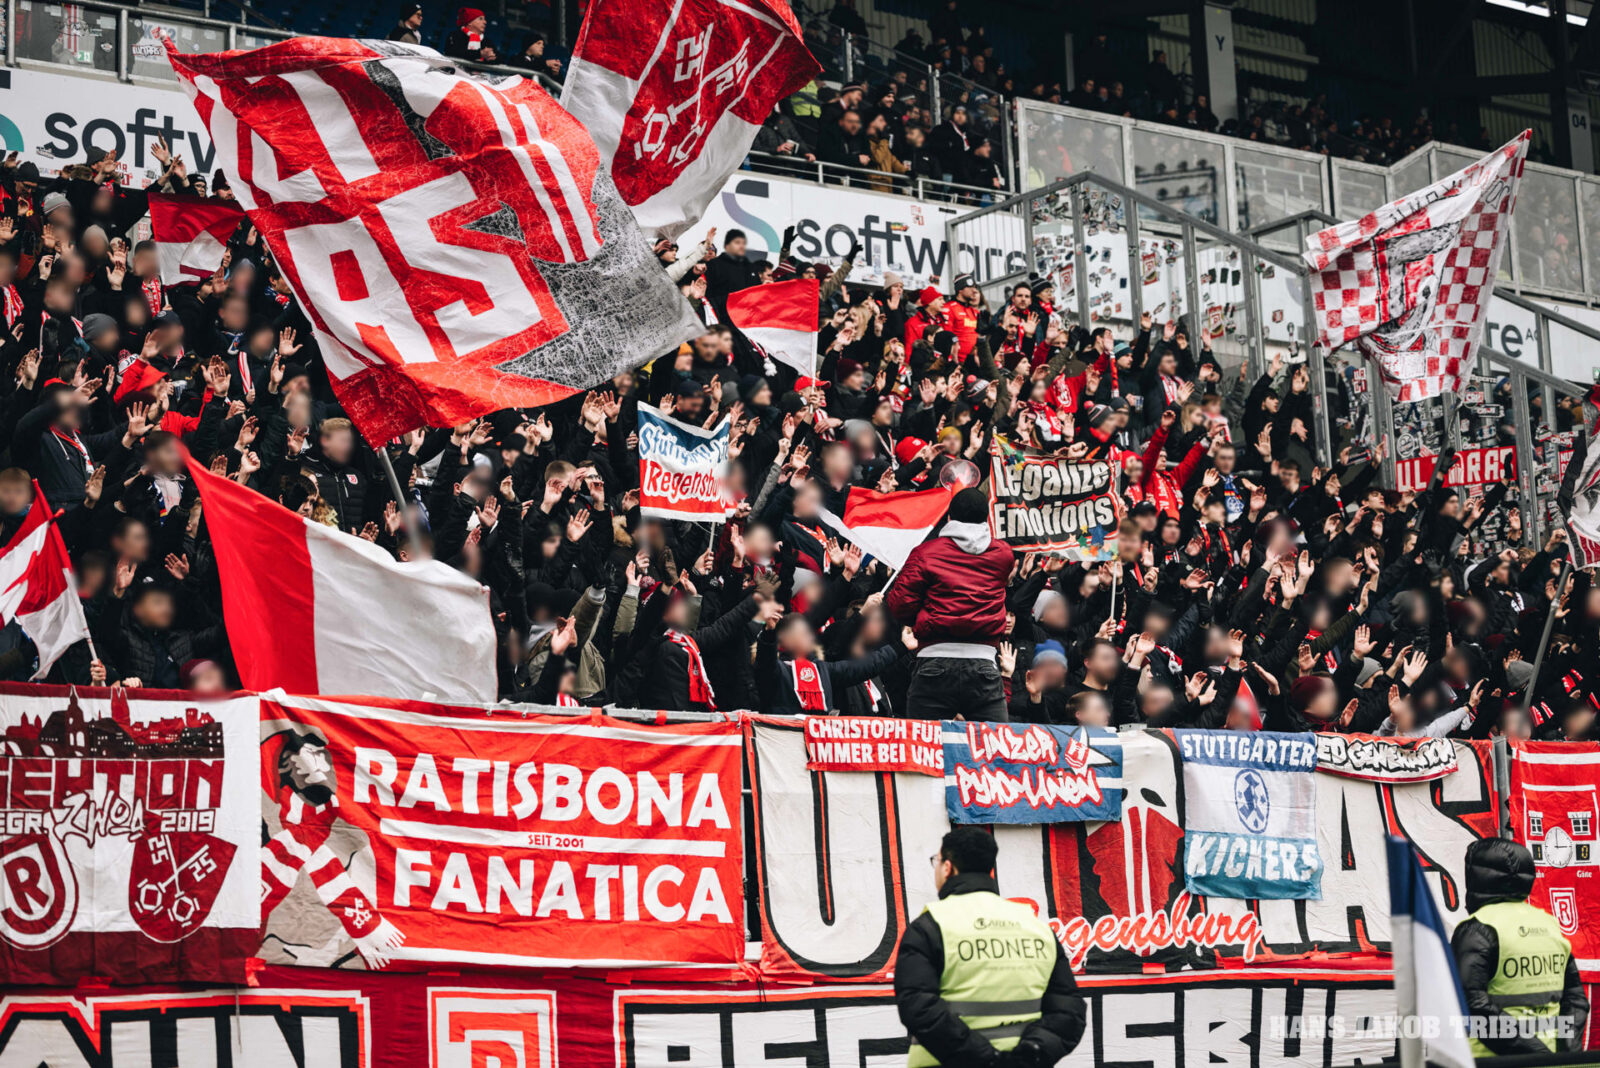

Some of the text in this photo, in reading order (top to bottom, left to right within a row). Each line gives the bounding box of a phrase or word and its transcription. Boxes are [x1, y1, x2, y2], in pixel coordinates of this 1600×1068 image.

[796, 214, 1028, 284] software
[992, 456, 1110, 501] Legalize
[994, 497, 1114, 539] Emotions
[808, 718, 943, 744] CHRISTOPH FÜR
[808, 742, 944, 770] IMMER BEI UNS
[1181, 734, 1316, 768] STUTTGARTER
[1316, 735, 1347, 766] ED
[353, 746, 732, 829] RATISBONA
[160, 811, 215, 833] 2019
[527, 834, 584, 849] SEIT 2001
[1186, 834, 1319, 881] KICKERS
[393, 848, 733, 923] FANATICA
[957, 937, 1048, 962] ORDNER
